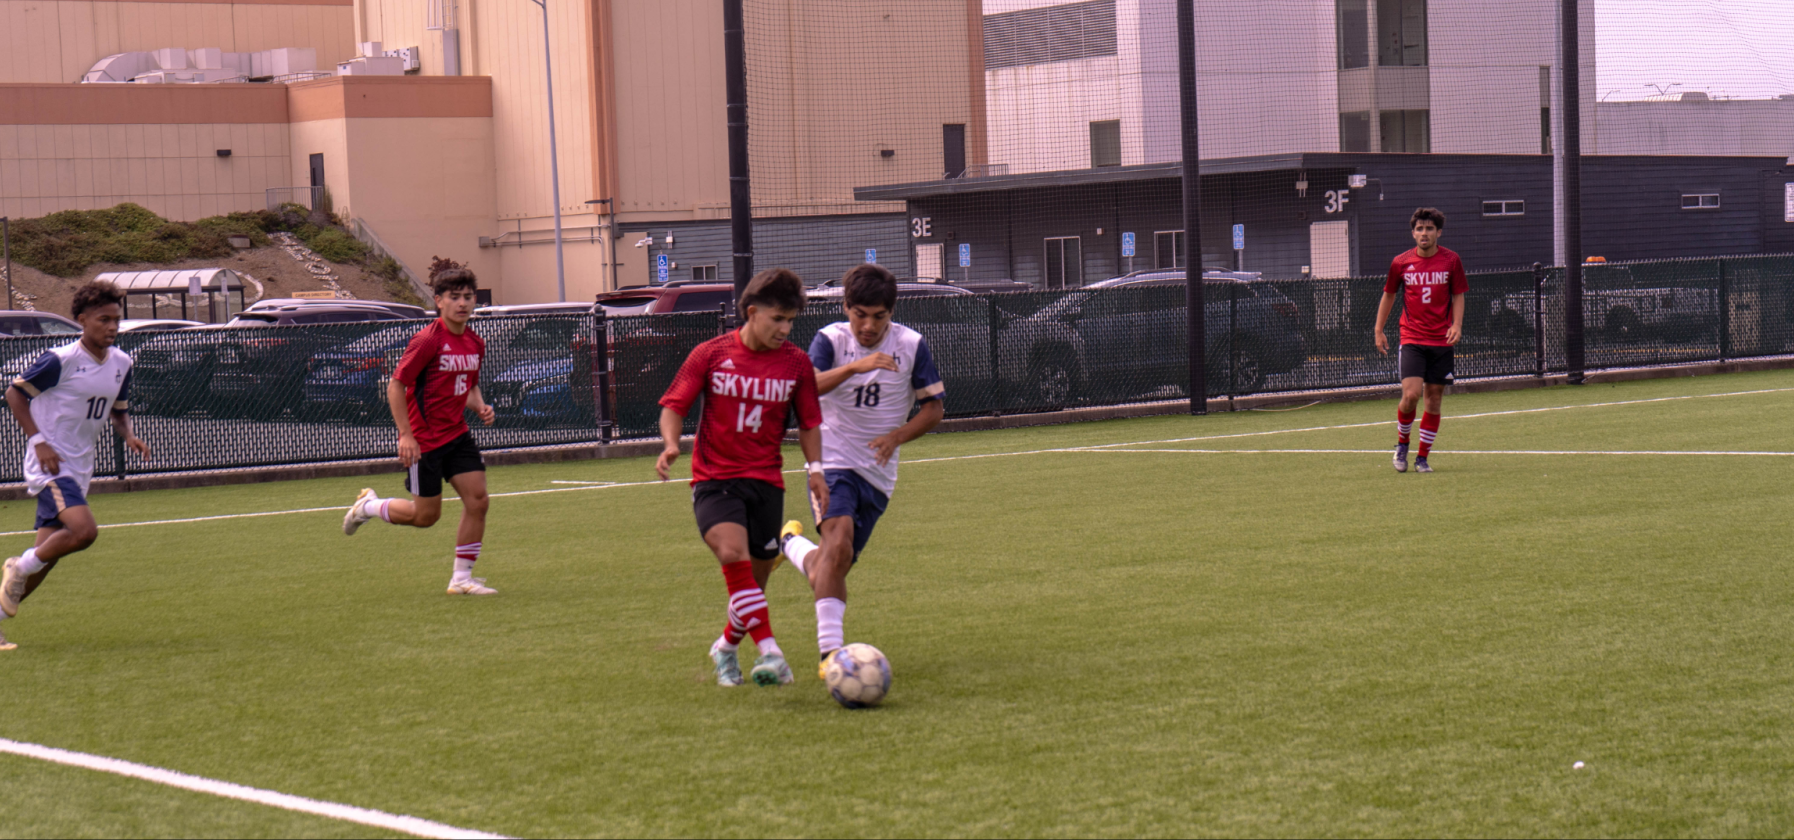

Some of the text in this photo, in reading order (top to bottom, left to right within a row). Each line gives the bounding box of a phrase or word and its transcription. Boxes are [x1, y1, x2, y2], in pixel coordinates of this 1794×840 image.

[1324, 189, 1349, 213] 3F
[912, 217, 932, 238] 3E
[1404, 271, 1449, 286] SKYLINE
[1422, 286, 1431, 304] 2
[454, 373, 468, 396] 16
[711, 371, 796, 402] SKYLINE
[853, 382, 880, 408] 18
[86, 396, 108, 420] 10
[736, 402, 763, 434] 14
